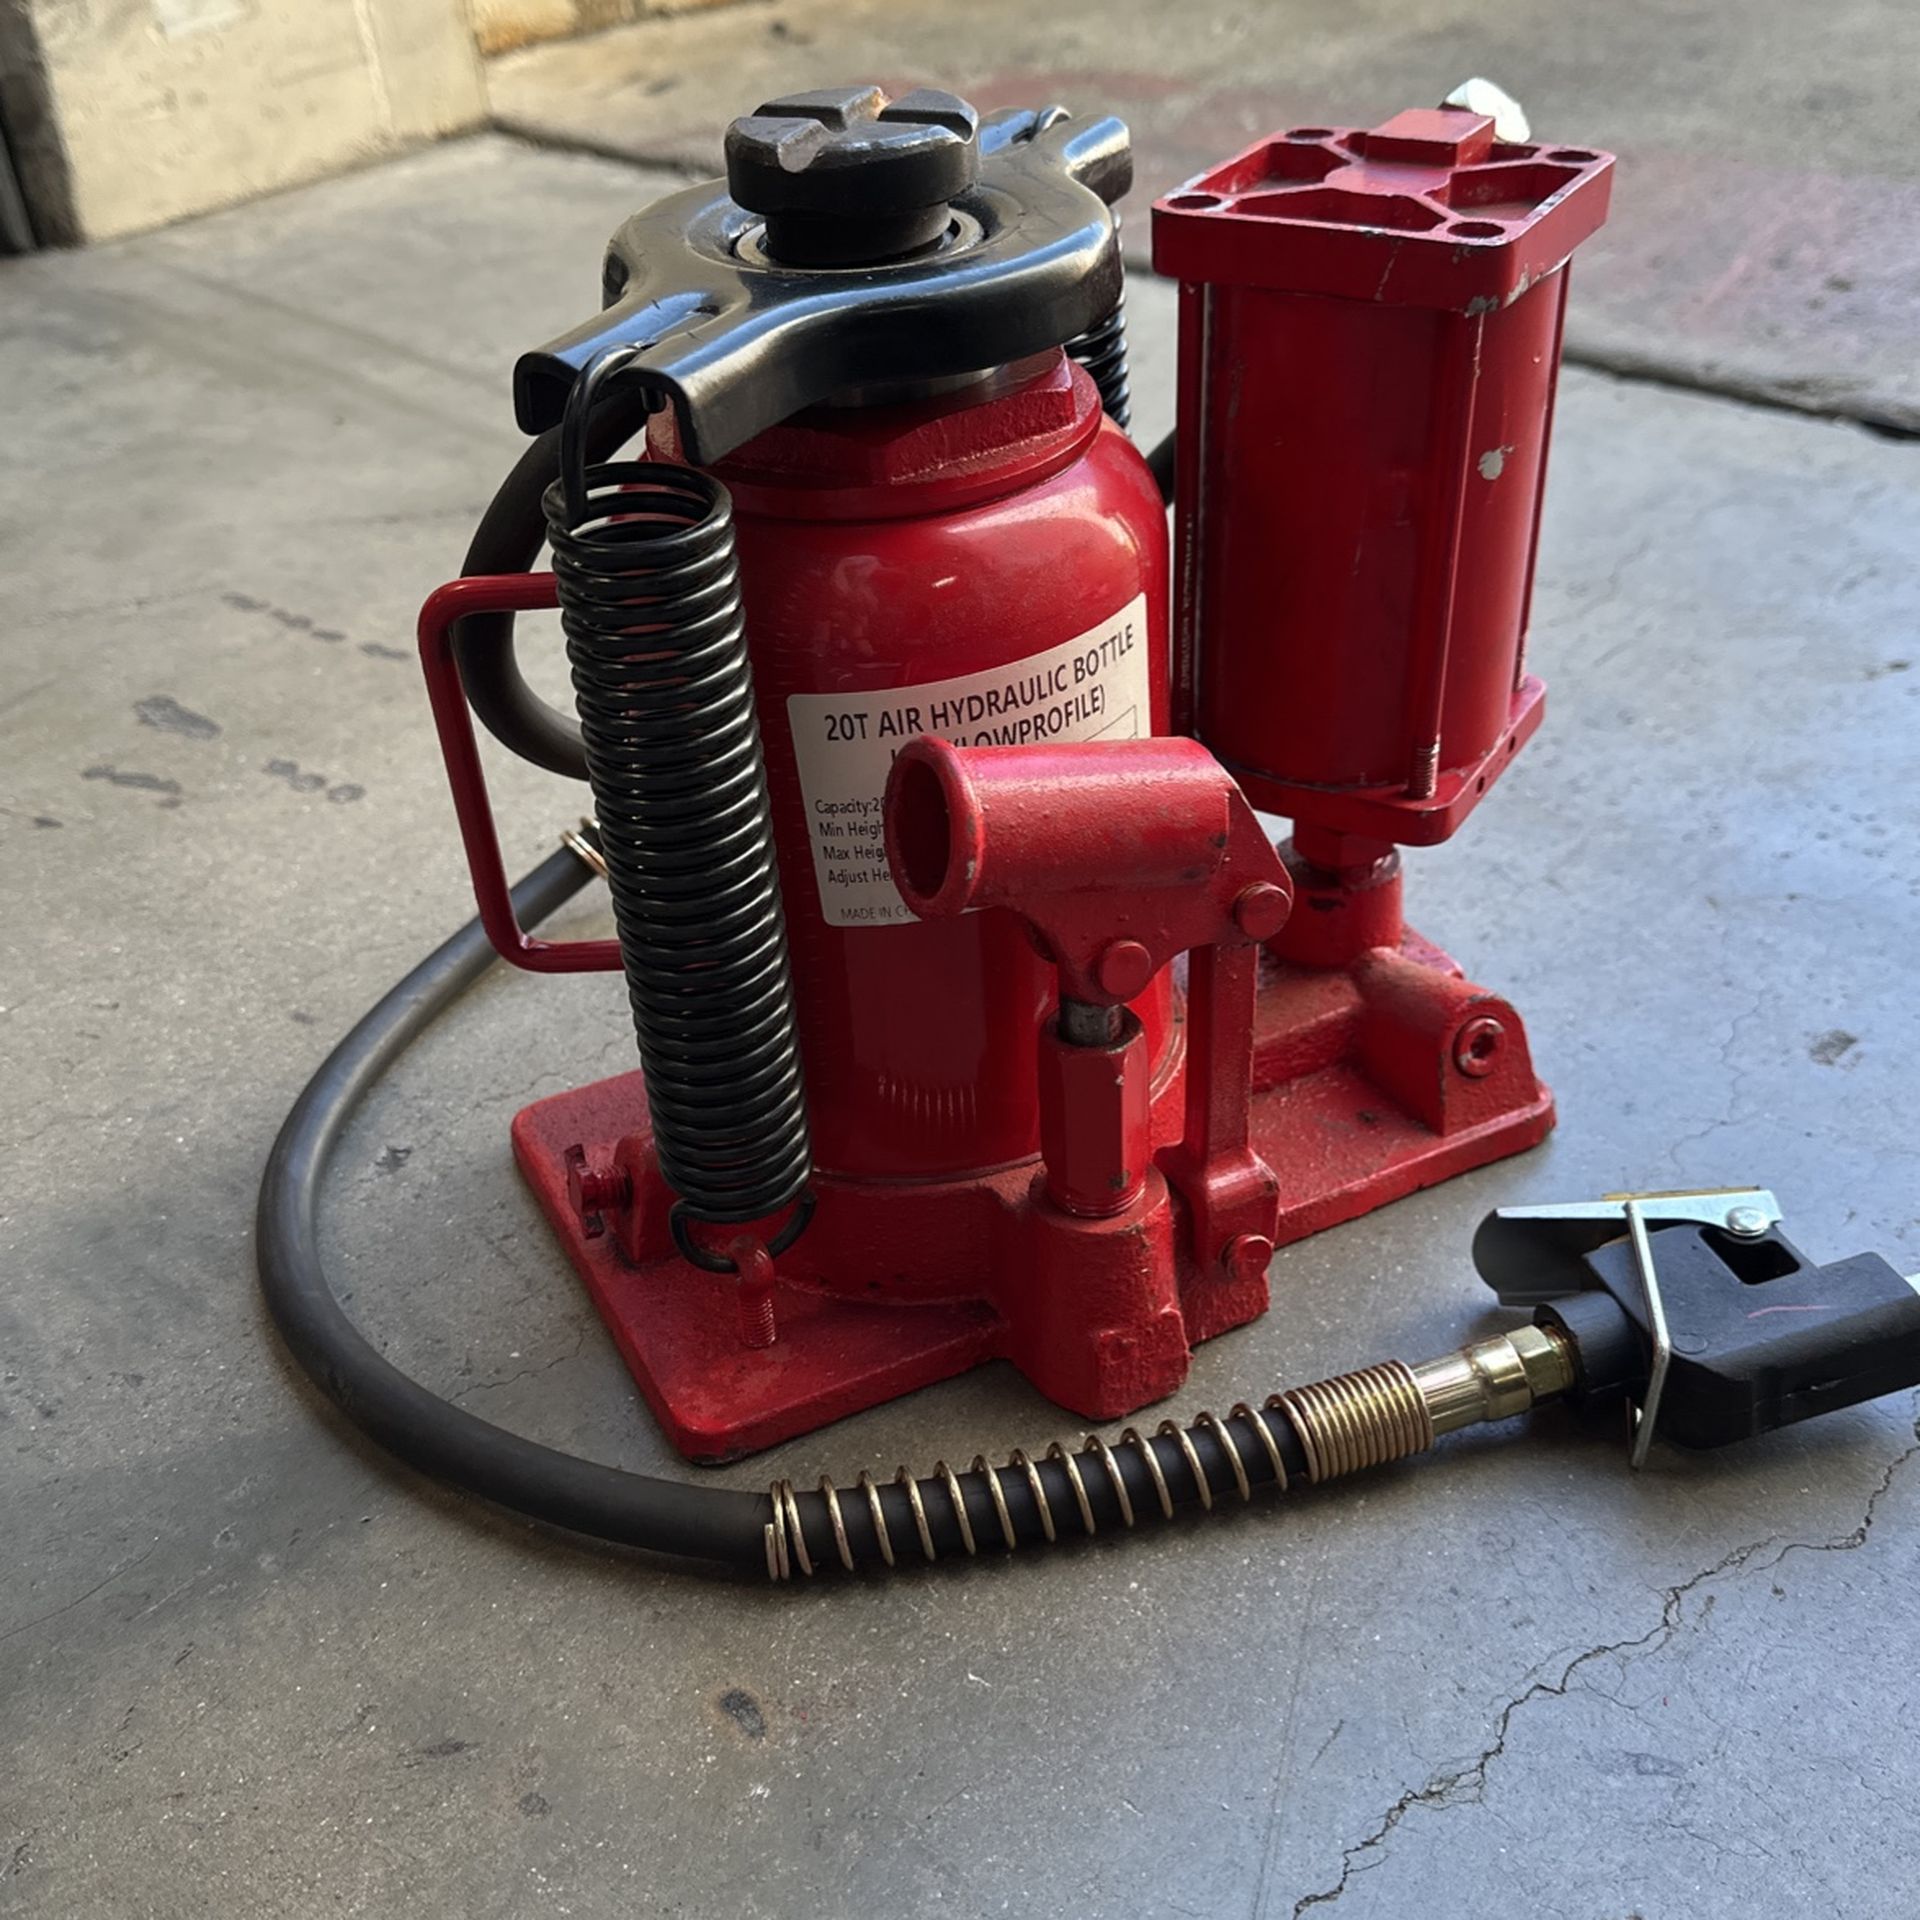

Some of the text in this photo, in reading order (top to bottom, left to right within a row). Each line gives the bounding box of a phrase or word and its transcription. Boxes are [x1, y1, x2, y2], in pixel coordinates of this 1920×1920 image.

[824, 623, 1134, 741] 20T AIR HYDRAULIC BOTTLE
[819, 822, 844, 837] Min
[823, 844, 885, 863] Max Heig
[828, 869, 869, 888] Adjust
[841, 906, 876, 921] MADE
[880, 906, 892, 918] IN
